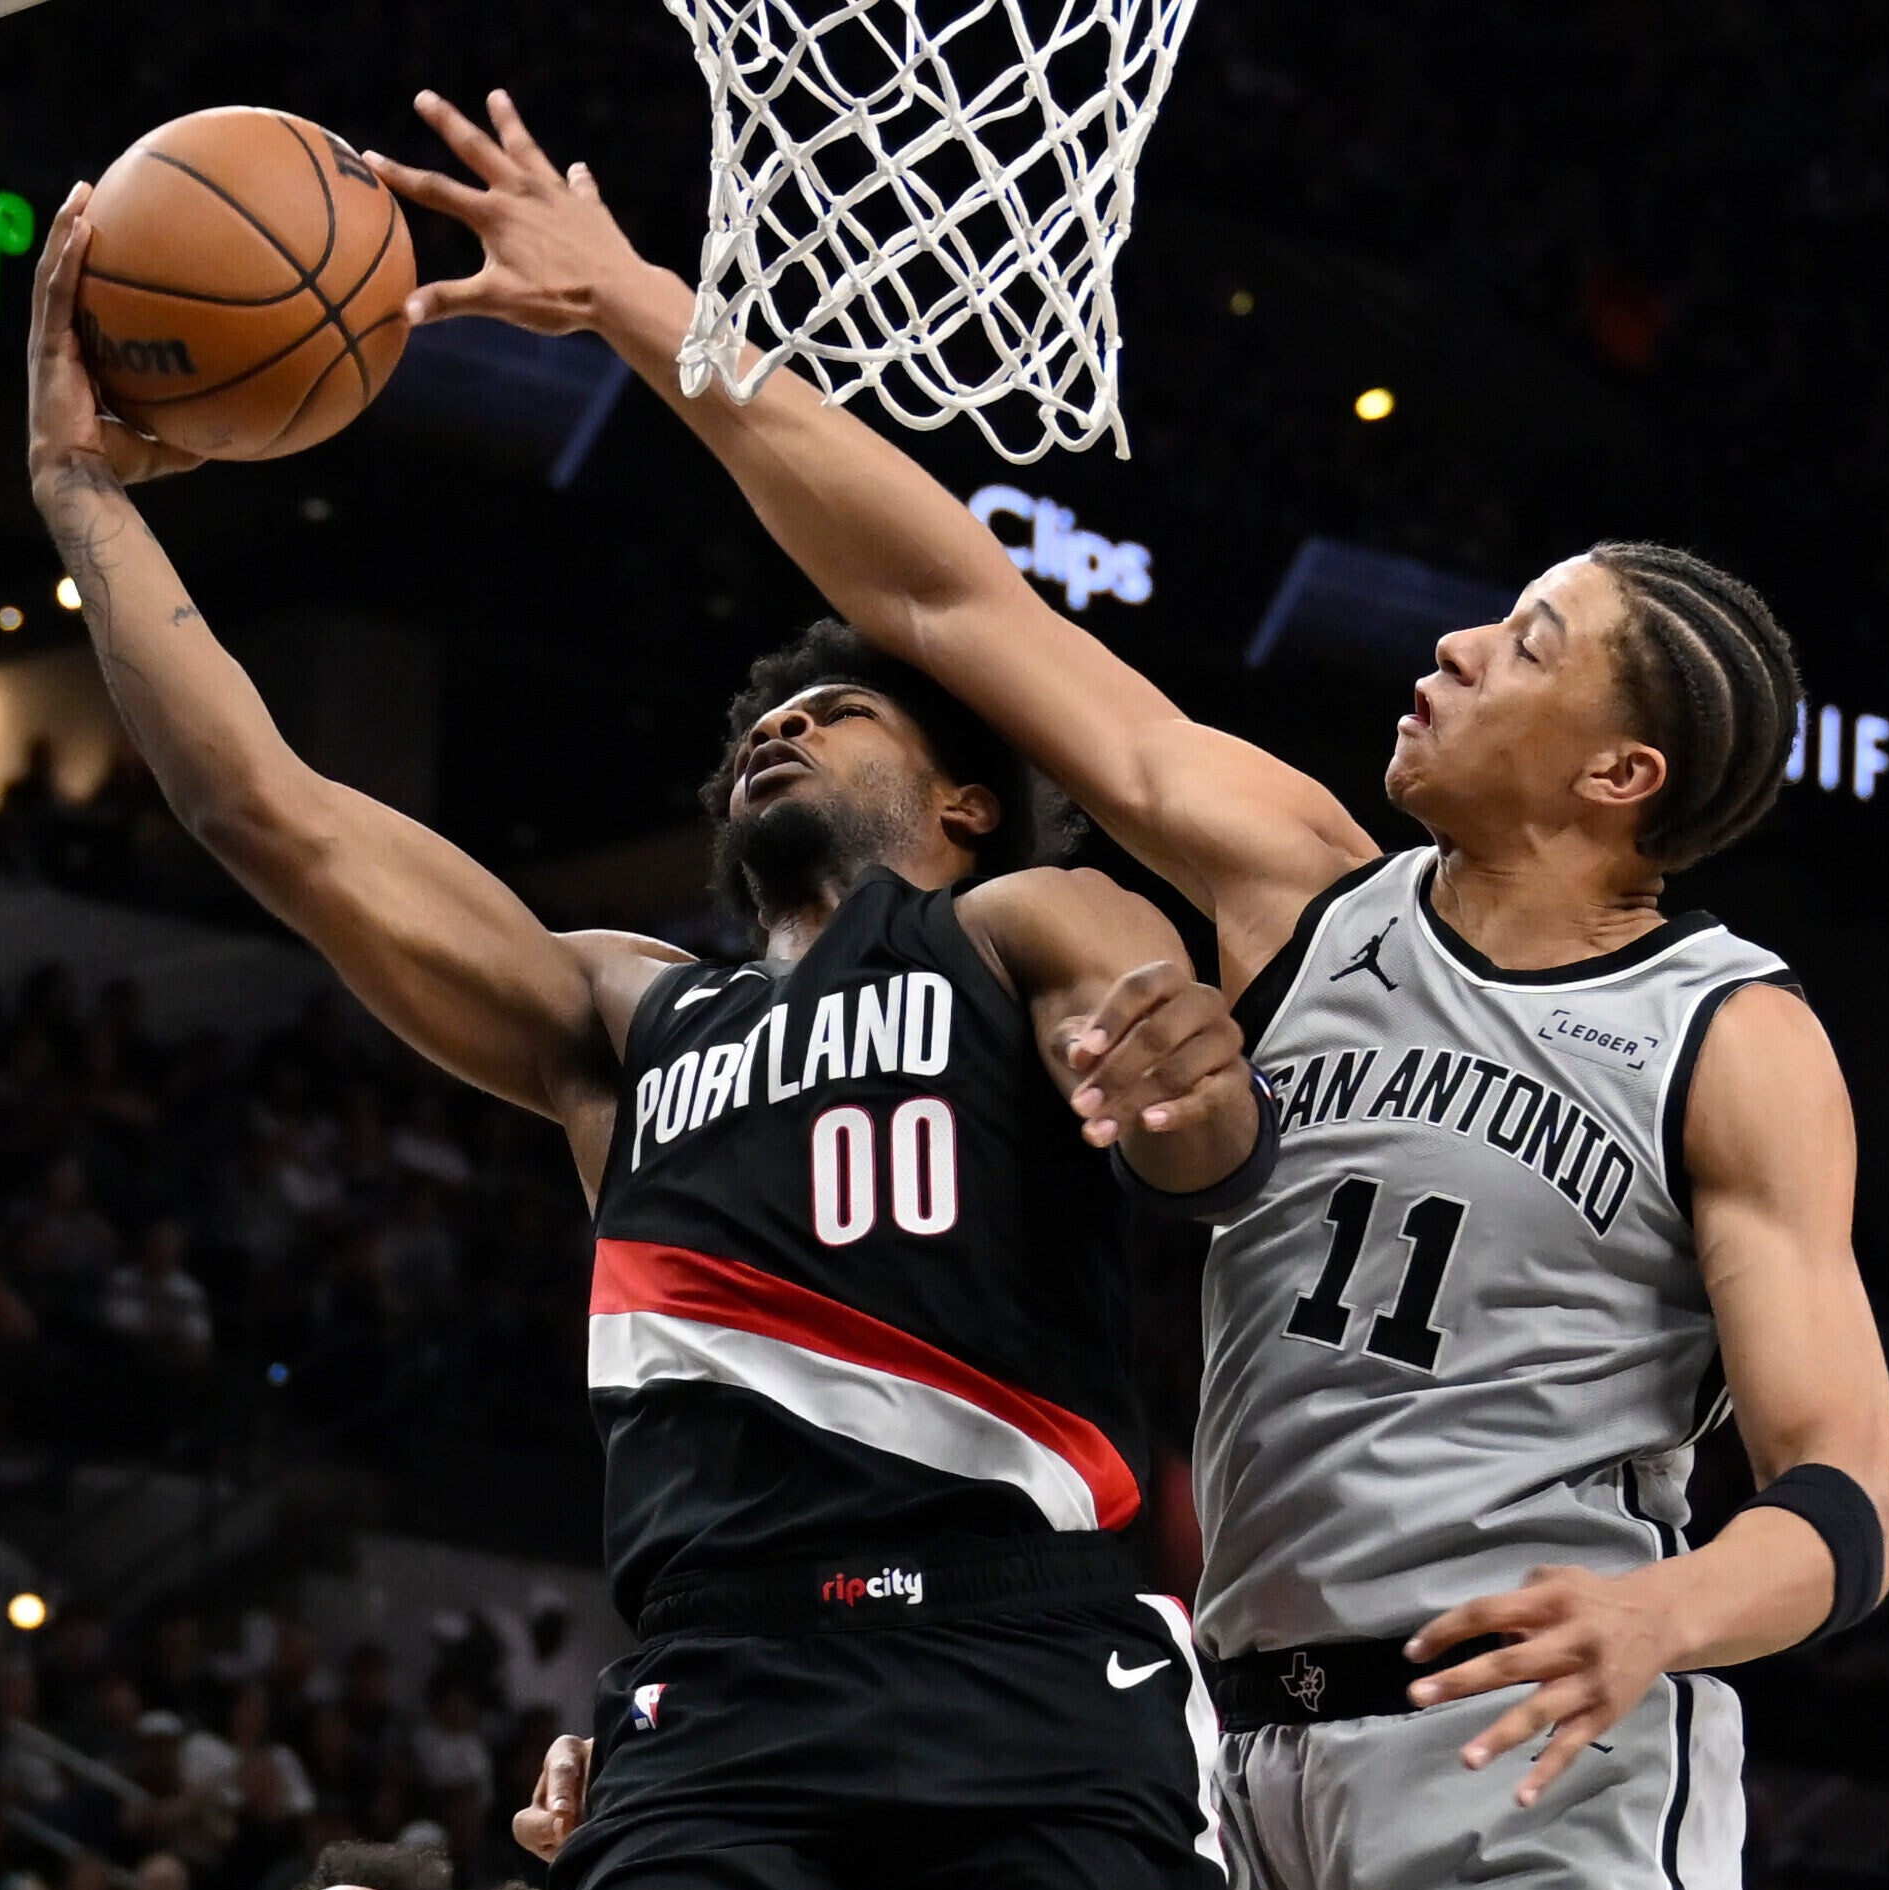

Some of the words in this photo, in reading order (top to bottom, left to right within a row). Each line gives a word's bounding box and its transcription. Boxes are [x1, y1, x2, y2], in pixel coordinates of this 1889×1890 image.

[969, 484, 1153, 611] Clips
[631, 971, 954, 1174] PORTLAND
[1557, 1019, 1638, 1056] LEDGER
[810, 1094, 959, 1247] 00
[1362, 1046, 1636, 1240] ANTONIO
[1282, 1173, 1471, 1375] 11
[821, 1566, 924, 1607] ripcity
